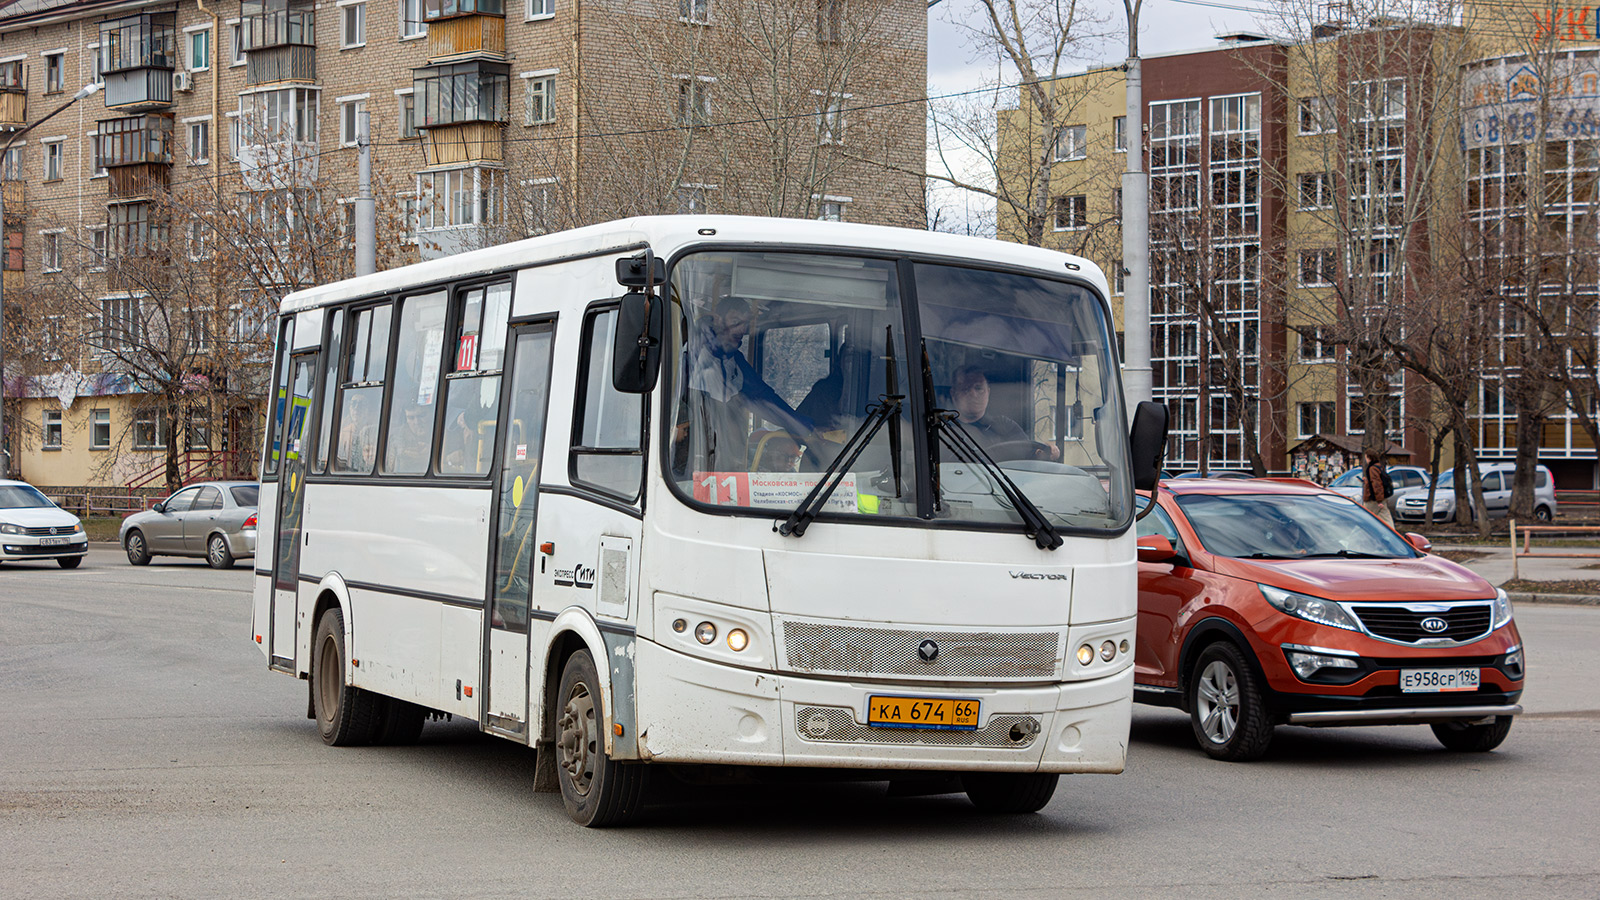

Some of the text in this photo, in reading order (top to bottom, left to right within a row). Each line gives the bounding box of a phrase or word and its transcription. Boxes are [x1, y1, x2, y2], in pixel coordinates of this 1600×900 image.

[461, 338, 472, 368] 11
[701, 476, 737, 506] 11
[752, 479, 798, 488] Московская
[1425, 620, 1444, 630] KIA
[1458, 670, 1477, 681] 196
[910, 701, 945, 722] 674
[955, 702, 972, 717] 66
